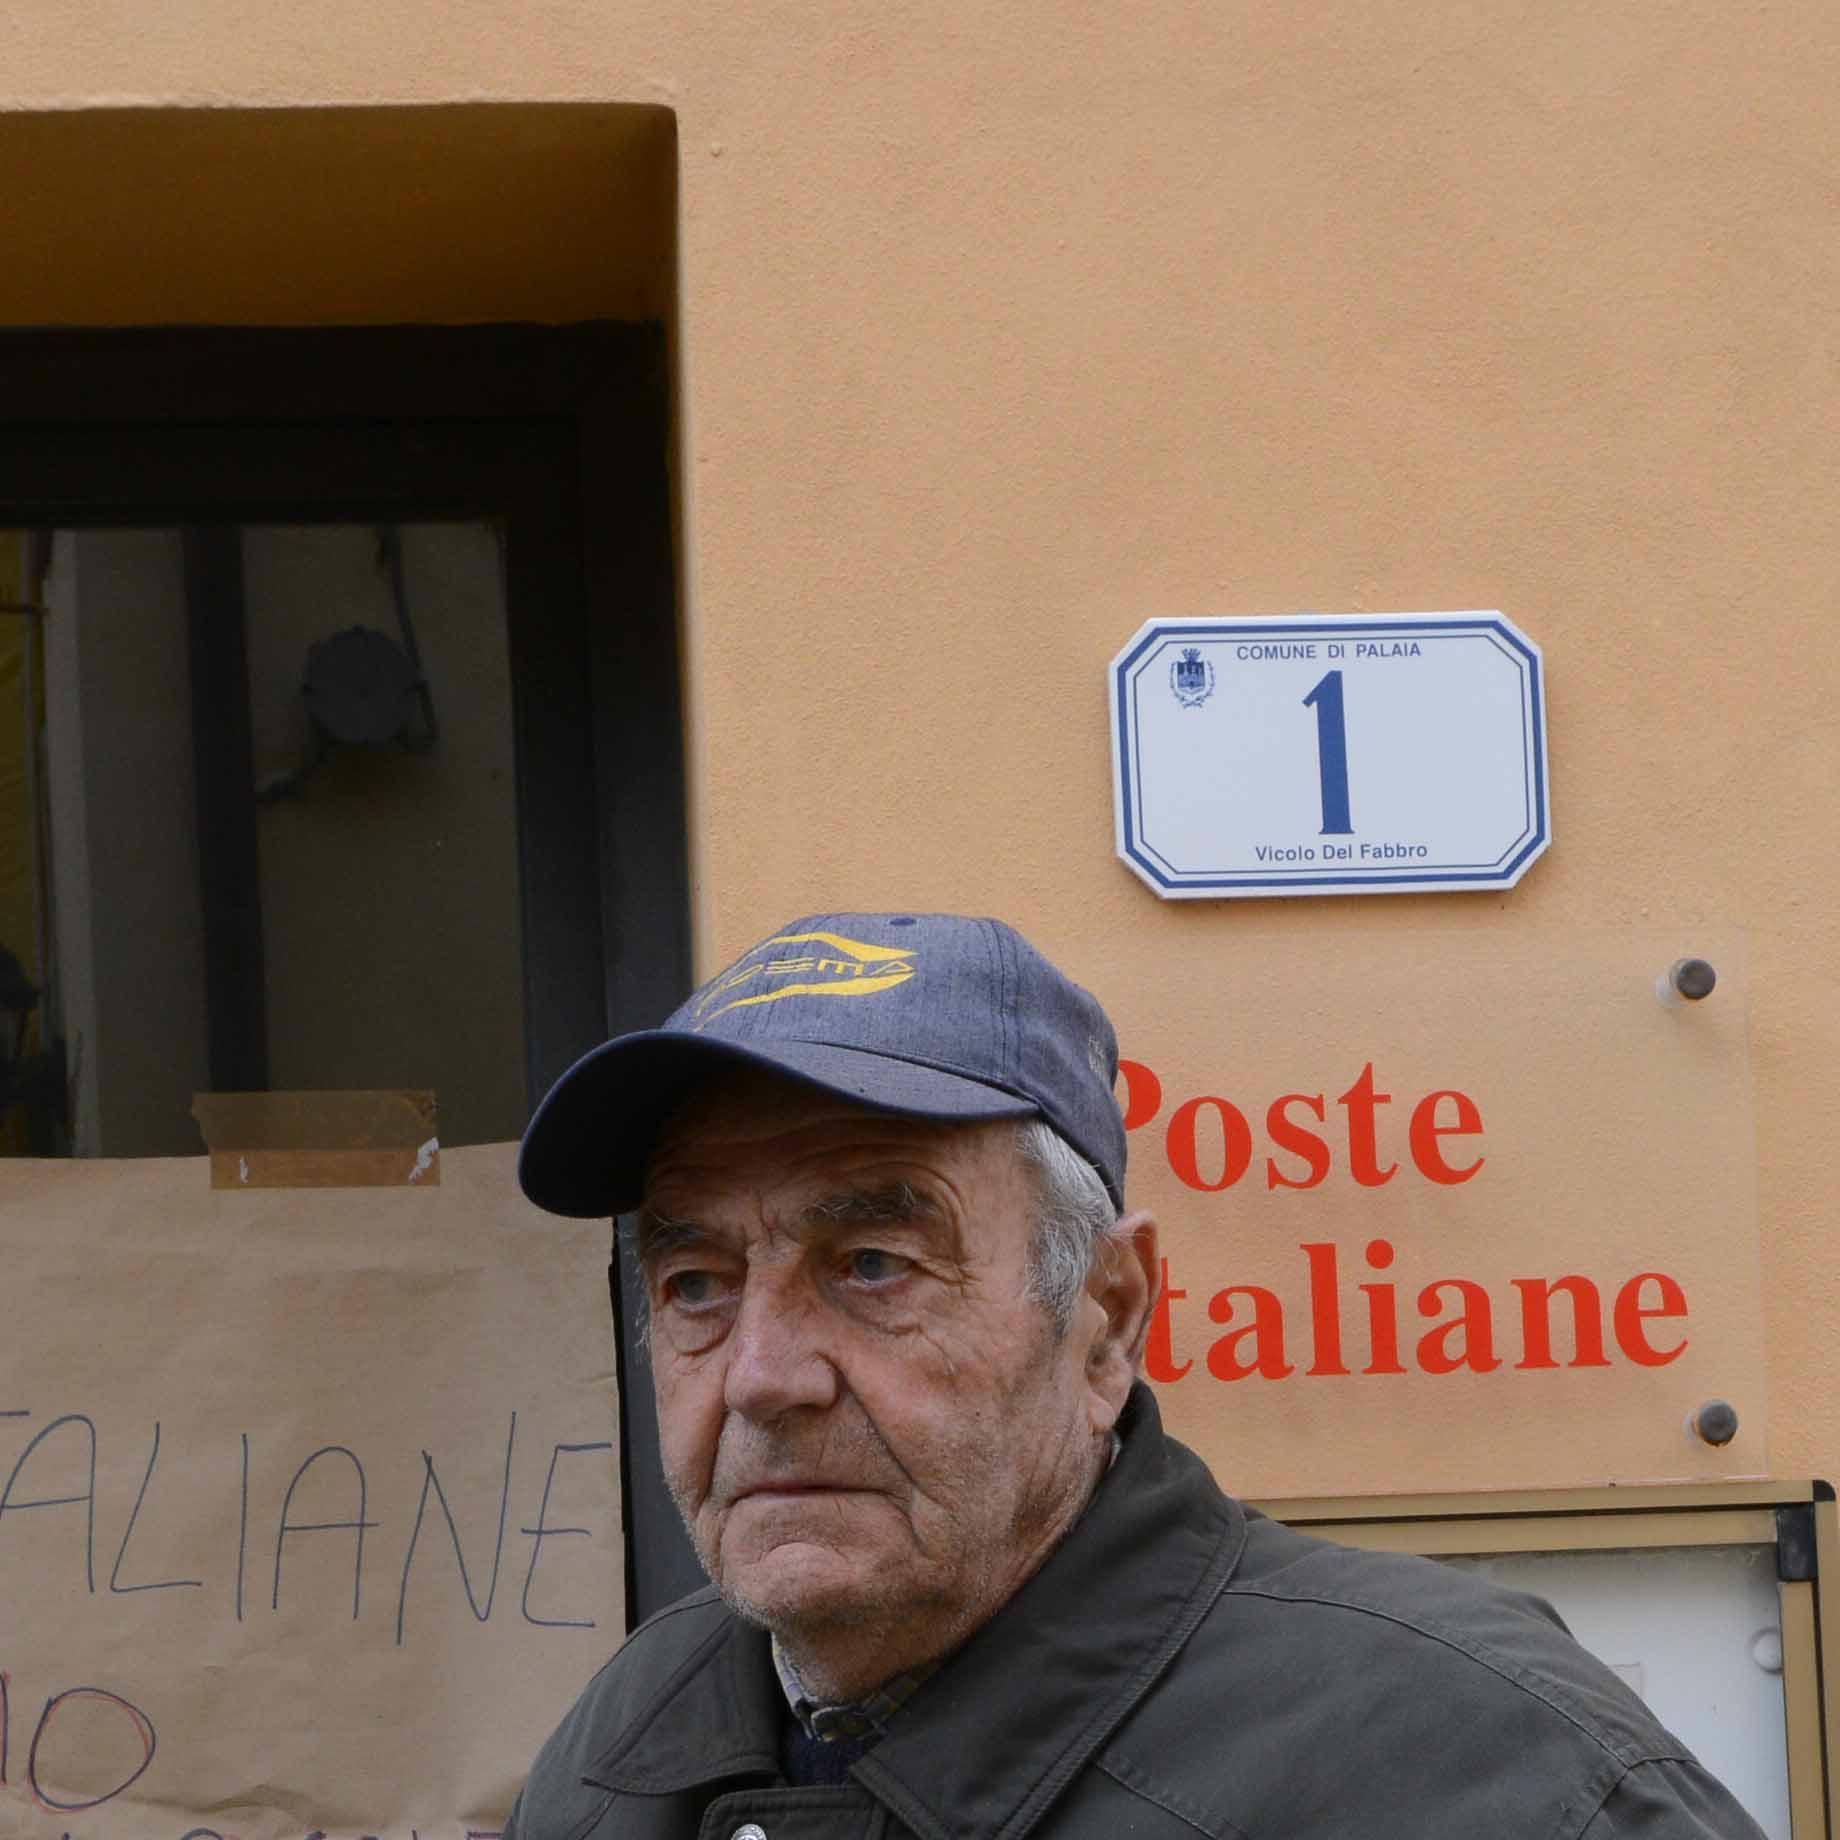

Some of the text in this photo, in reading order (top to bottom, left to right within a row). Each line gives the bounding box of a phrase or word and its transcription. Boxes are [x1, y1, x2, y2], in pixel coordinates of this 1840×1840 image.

[1236, 642, 1422, 661] COMUNE DI PALAIA
[1301, 669, 1356, 836] 1
[1255, 842, 1428, 863] Vicolo Del Fabbro
[1143, 1239, 1689, 1385] taliane
